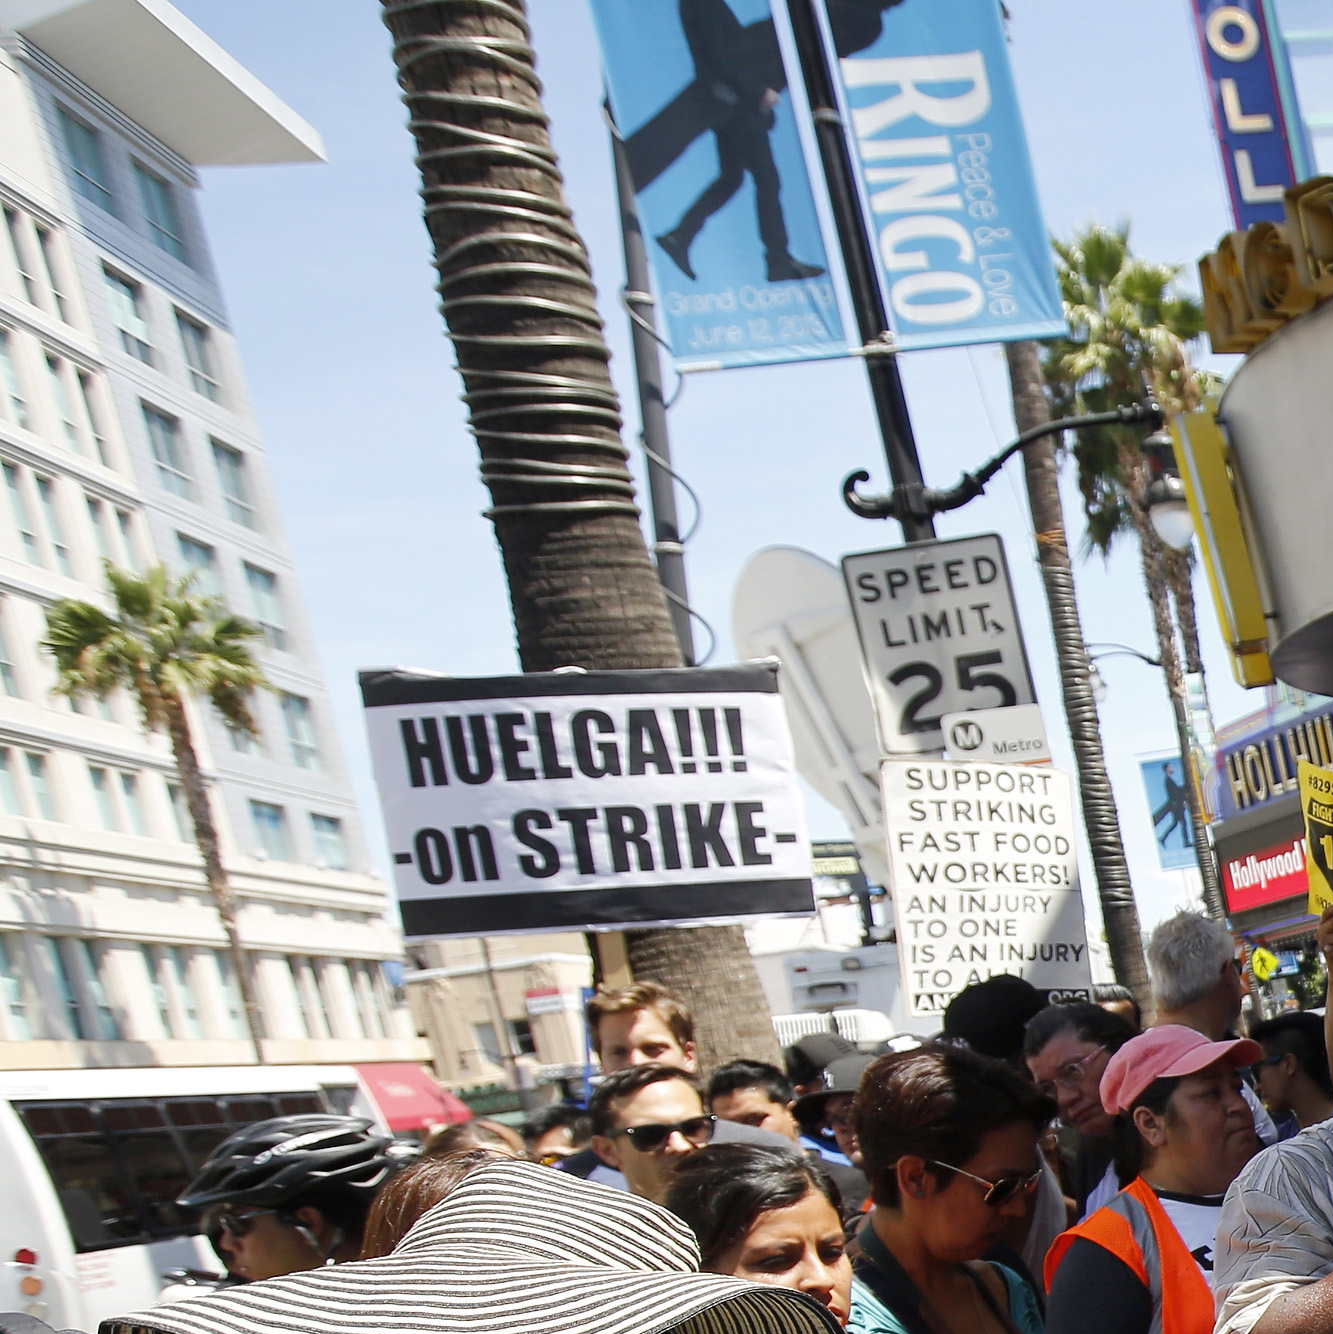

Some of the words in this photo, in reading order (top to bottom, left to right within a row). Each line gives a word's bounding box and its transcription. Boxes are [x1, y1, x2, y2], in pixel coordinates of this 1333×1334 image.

[840, 50, 992, 325] RINGO
[954, 132, 999, 220] Peace
[979, 252, 1019, 317] Love
[664, 284, 738, 317] Grand
[739, 282, 833, 311] Opening
[687, 323, 743, 349] June
[857, 555, 998, 603] SPEED
[880, 602, 990, 647] LIMIT
[888, 649, 1017, 735] 25
[400, 708, 748, 787] HUELGA!!!
[993, 737, 1043, 755] Metro
[906, 767, 1052, 796] SUPPORT
[909, 799, 1056, 825] STRIKING
[393, 823, 500, 885] -on
[513, 802, 797, 879] STRIKE-
[897, 831, 980, 853] FAST
[993, 833, 1069, 856] FOOD
[907, 862, 1070, 885] WORKERS!
[1229, 839, 1304, 890] Hollywood
[906, 894, 946, 914] AN
[958, 894, 1052, 914] INJURY
[907, 919, 948, 939] TO
[958, 918, 1017, 938] ONE
[911, 944, 936, 964] IS
[947, 943, 987, 963] AN
[1000, 942, 1084, 963] INJURY
[914, 968, 953, 989] TO
